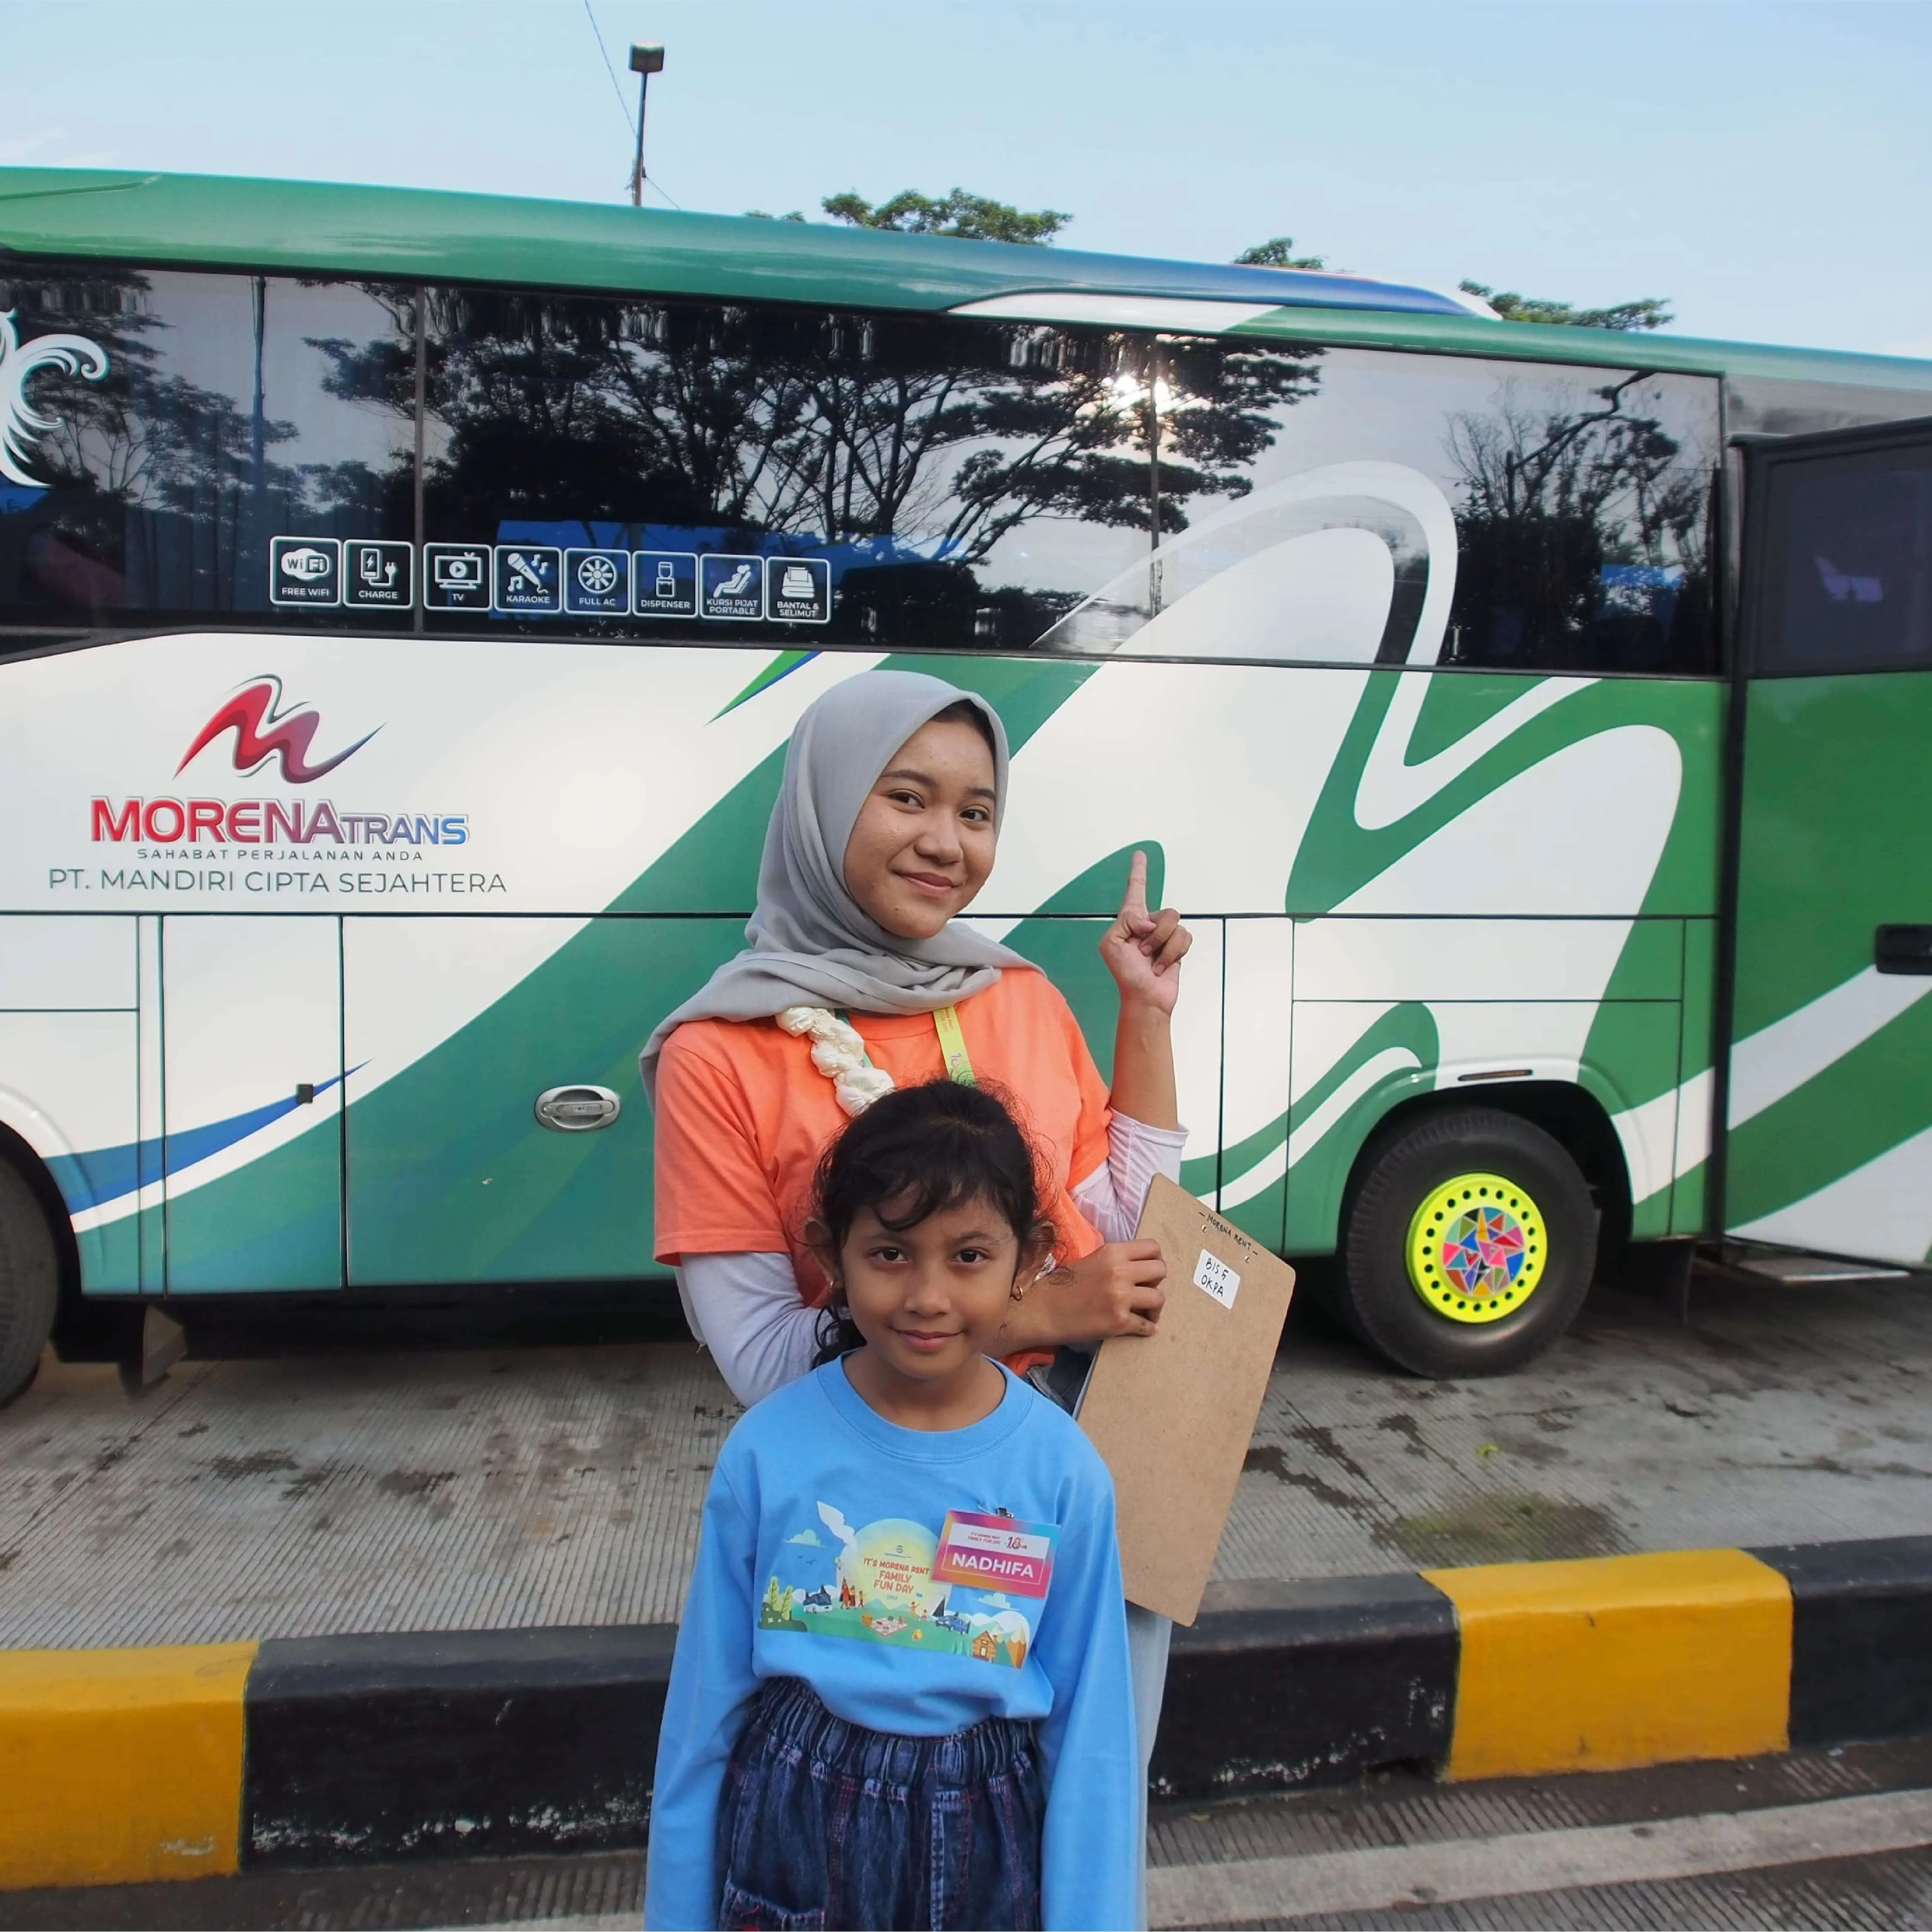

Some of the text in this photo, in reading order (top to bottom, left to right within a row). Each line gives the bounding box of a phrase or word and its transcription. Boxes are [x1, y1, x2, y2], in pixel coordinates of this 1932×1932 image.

[282, 587, 329, 596] FREE WIFI
[358, 590, 398, 599] CHARGE
[507, 595, 550, 604] KARAOKE
[641, 600, 690, 609] DISPENSER
[735, 599, 758, 607] PIJAT
[709, 606, 755, 615] PORTABLE
[777, 601, 812, 610] BANTAL
[779, 609, 816, 617] SELIMUT
[137, 848, 423, 861] SAHABAT PERJALANAN ANDA
[49, 868, 507, 893] PT. MANDIRI CIPTA SEJAHTERA
[1207, 1213, 1251, 1250] MORENA RENT
[1205, 1258, 1220, 1274] BIS
[1201, 1275, 1224, 1296] OKPA
[864, 1557, 878, 1567] IT'S
[952, 1552, 1034, 1578] NADHIFA
[880, 1570, 912, 1583] FAMILY
[873, 1579, 914, 1594] FUN DAY
